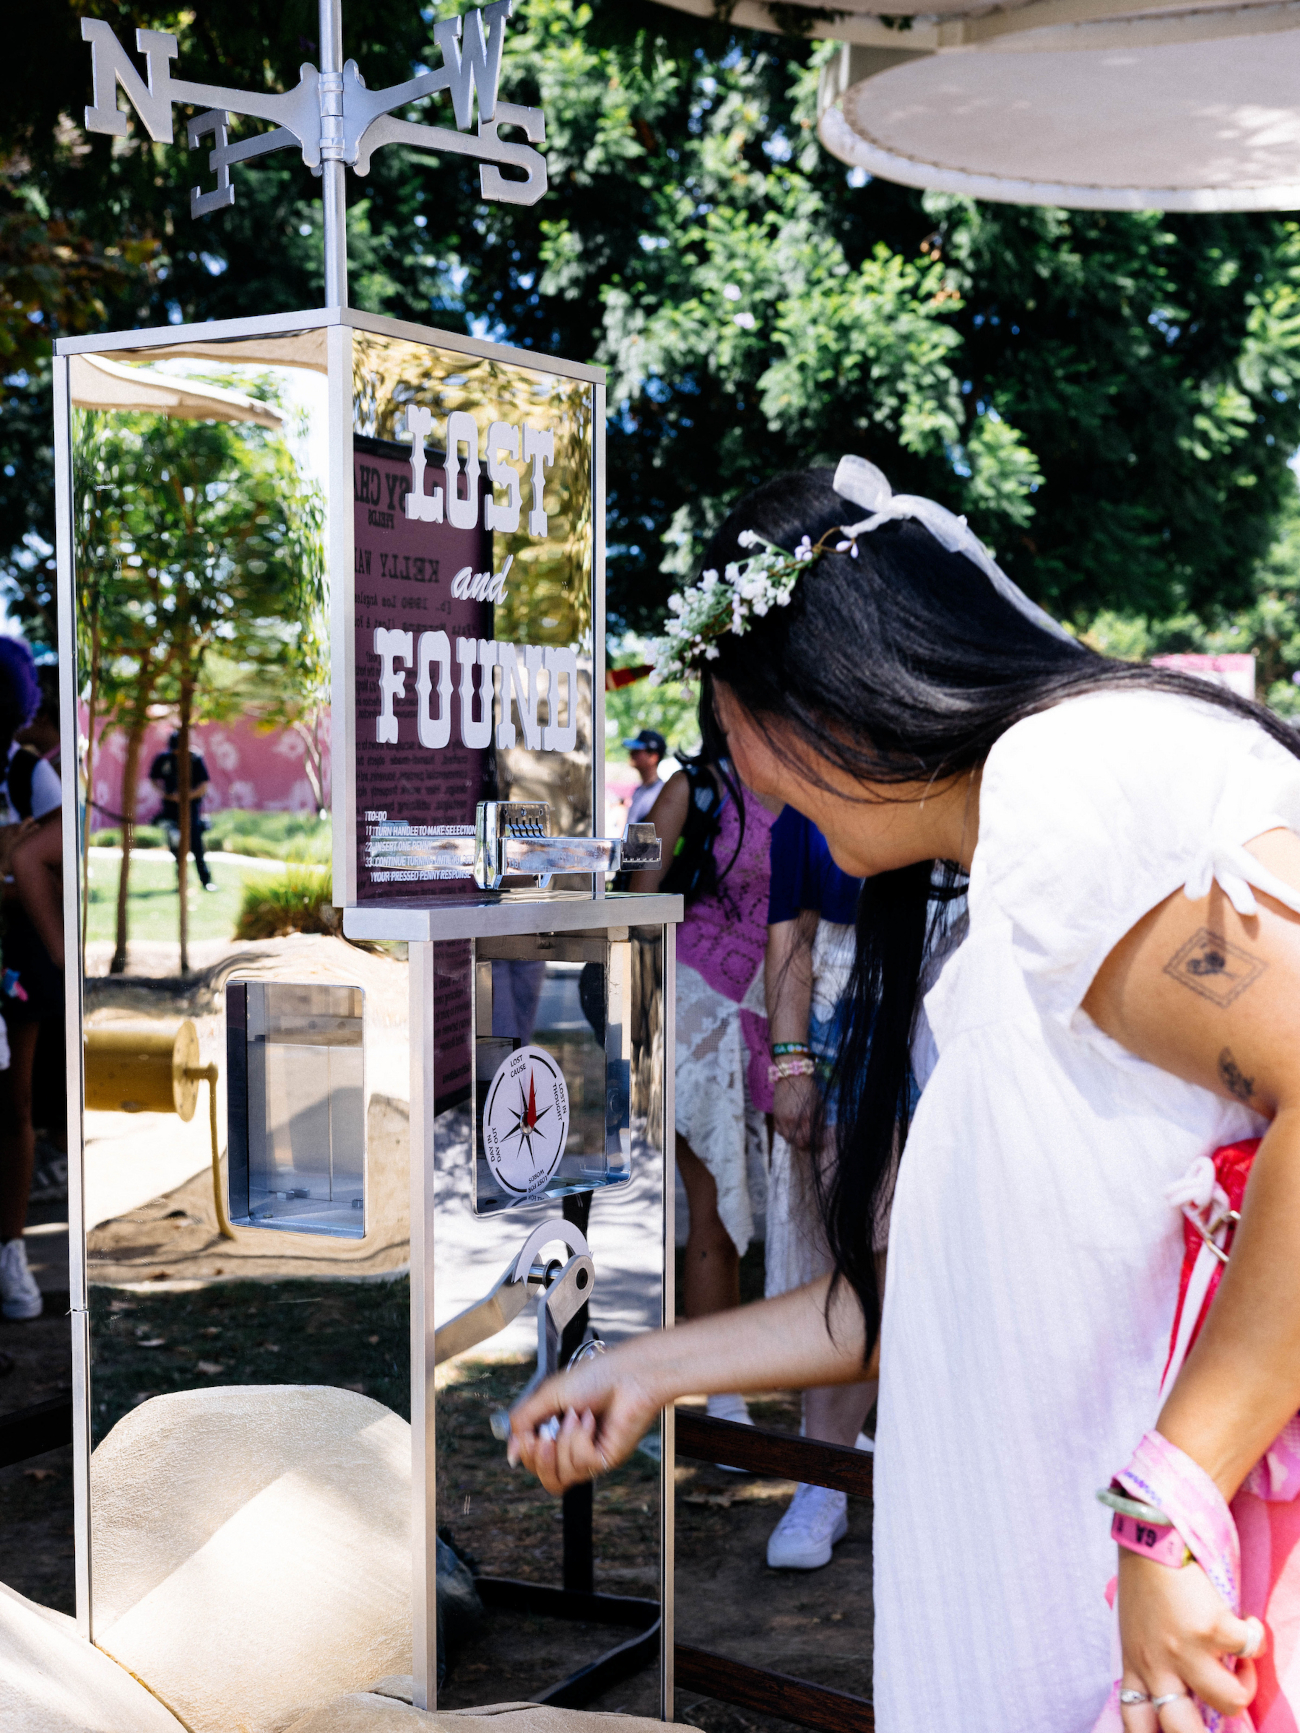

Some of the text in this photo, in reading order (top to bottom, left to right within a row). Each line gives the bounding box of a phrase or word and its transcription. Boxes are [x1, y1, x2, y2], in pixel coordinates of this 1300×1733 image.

[80, 16, 178, 144] N
[433, 0, 513, 131] W
[477, 101, 548, 206] S
[405, 404, 554, 537] LOST
[451, 555, 514, 605] and
[373, 627, 579, 752] FOUND
[373, 825, 392, 836] TURN
[393, 825, 418, 836] HANDLE
[419, 825, 427, 836] TO
[427, 825, 445, 836] MAKE
[445, 825, 477, 836] SELECTION
[371, 871, 390, 882] YOUR
[390, 870, 418, 882] PRESSED
[419, 870, 440, 881] PENNY
[510, 1054, 523, 1068] LOST
[510, 1062, 527, 1078] CAUSE
[552, 1082, 563, 1122] THOUGHT
[558, 1082, 568, 1115] LOST IN
[491, 1127, 499, 1144] OUT
[527, 1168, 545, 1184] WORDS
[527, 1175, 548, 1194] LOST FOR
